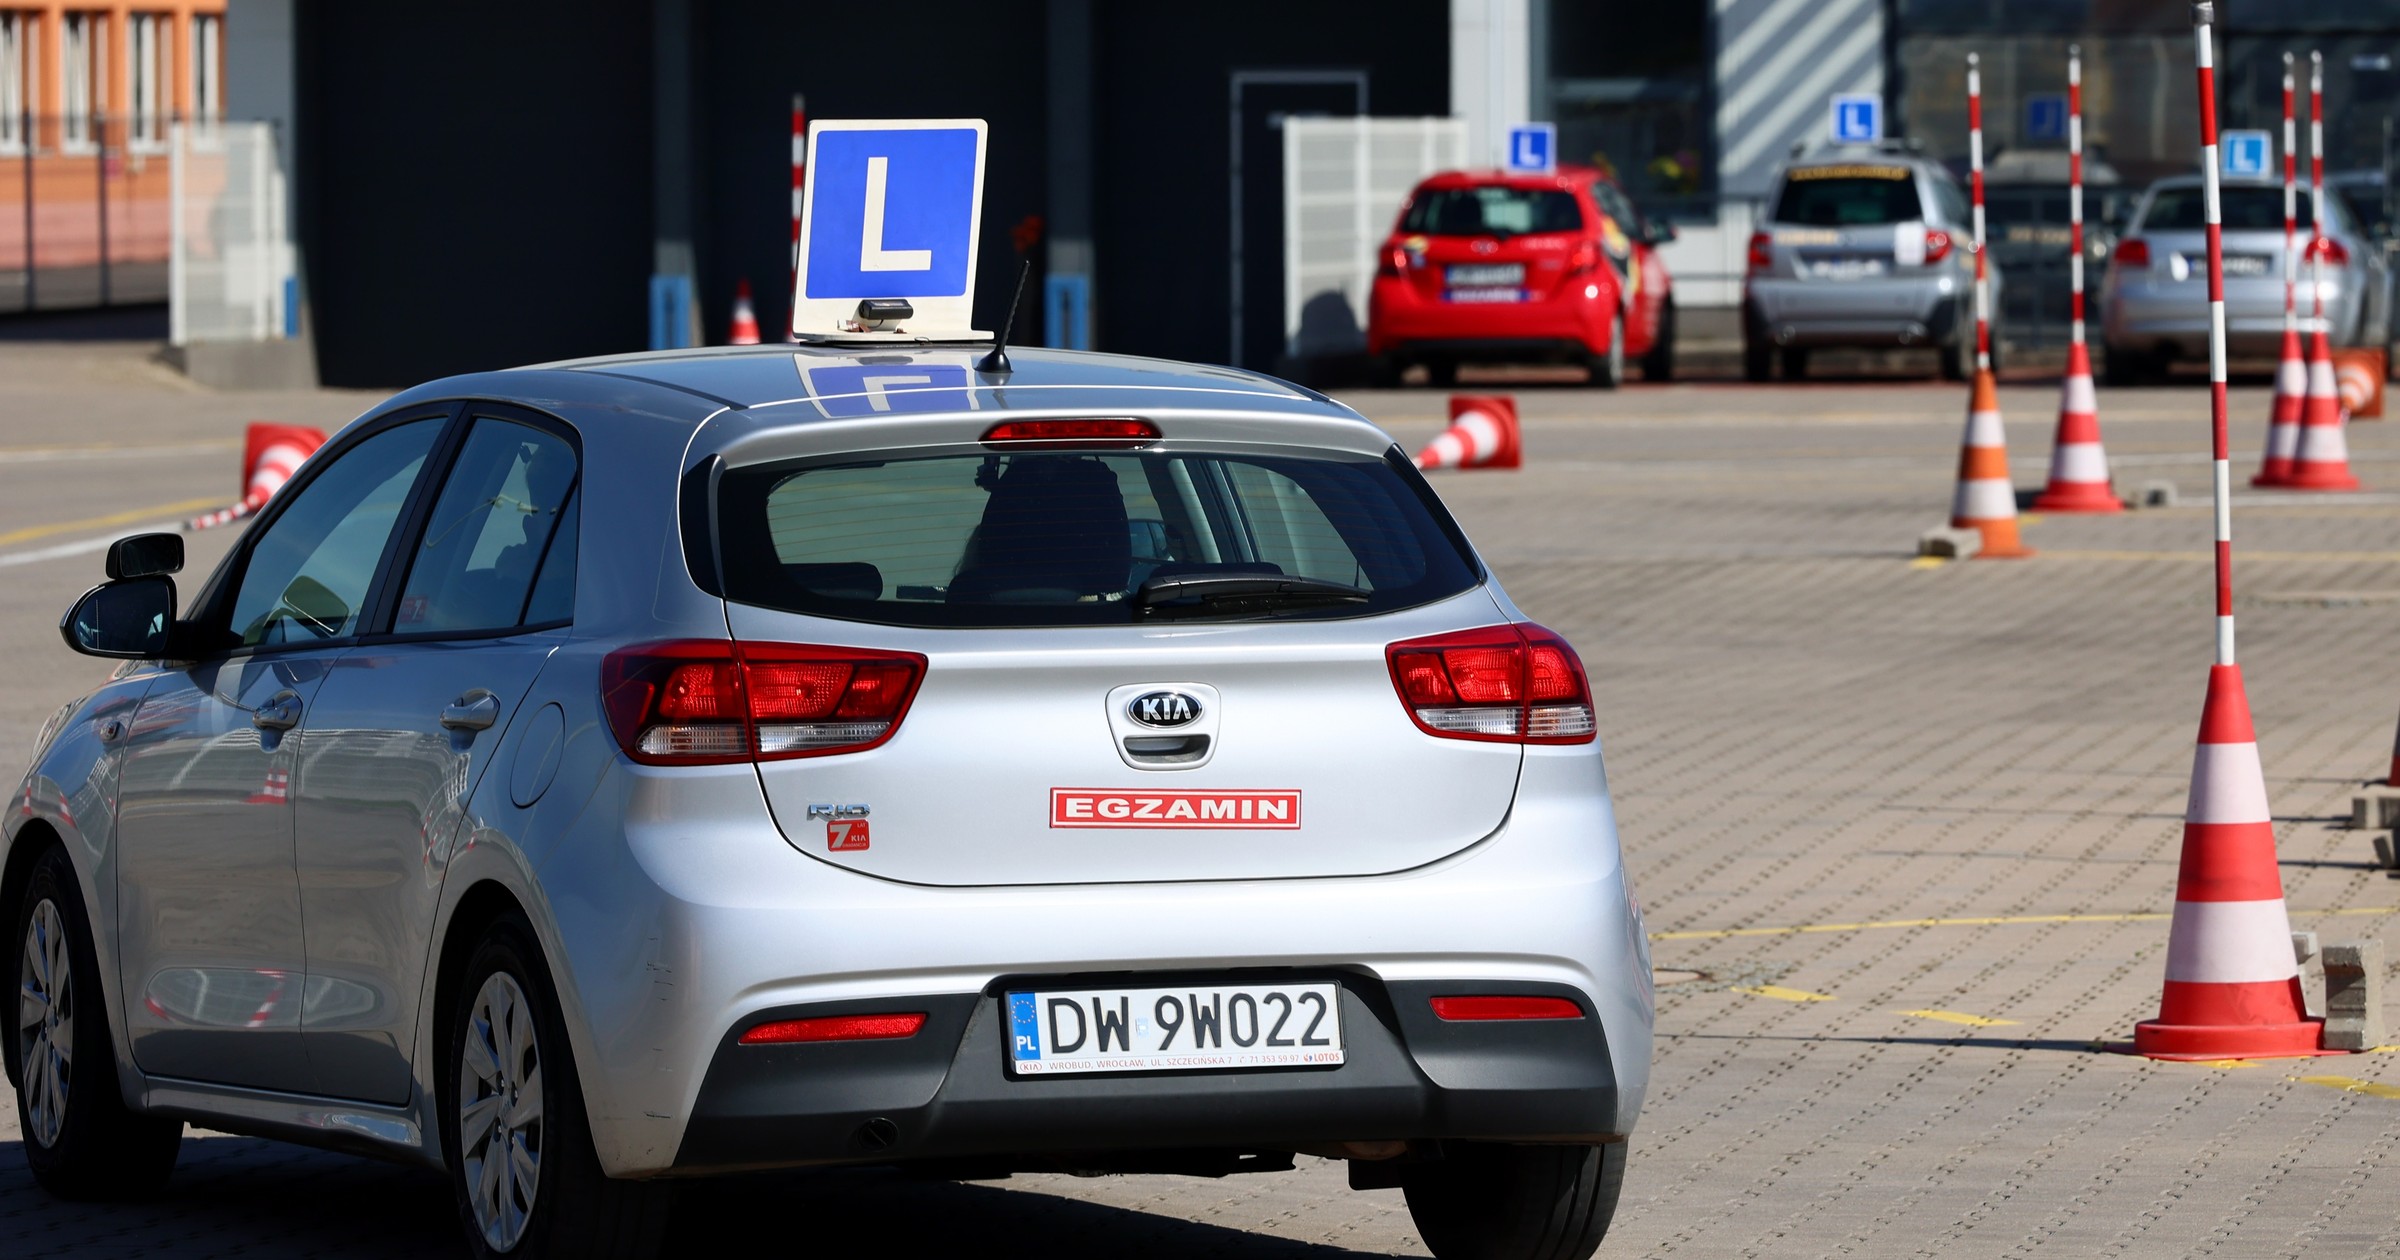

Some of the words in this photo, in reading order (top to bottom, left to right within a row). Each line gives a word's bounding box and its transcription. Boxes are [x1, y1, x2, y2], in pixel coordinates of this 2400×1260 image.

[1846, 105, 1869, 138] L
[1519, 133, 1542, 166] L
[2232, 141, 2256, 172] L
[860, 156, 932, 272] L
[1142, 697, 1192, 721] KIA
[807, 804, 870, 822] RIO
[1066, 797, 1289, 820] EGZAMIN
[830, 823, 852, 848] 7
[851, 834, 866, 842] KIA
[1047, 996, 1130, 1054] DW
[1154, 991, 1330, 1051] 9W022
[1016, 1036, 1036, 1051] PL
[1023, 1063, 1040, 1071] KIA
[1049, 1061, 1094, 1071] WROBUD,
[1096, 1060, 1146, 1069] WROCŁAW,
[1151, 1058, 1164, 1067] UL.
[1167, 1055, 1225, 1066] SZCZECIŃSKA
[1227, 1056, 1232, 1064] 7
[1250, 1055, 1259, 1063] 71
[1262, 1054, 1275, 1063] 353
[1278, 1054, 1288, 1062] 59
[1290, 1053, 1299, 1062] 97
[1314, 1053, 1340, 1062] LOTOS
